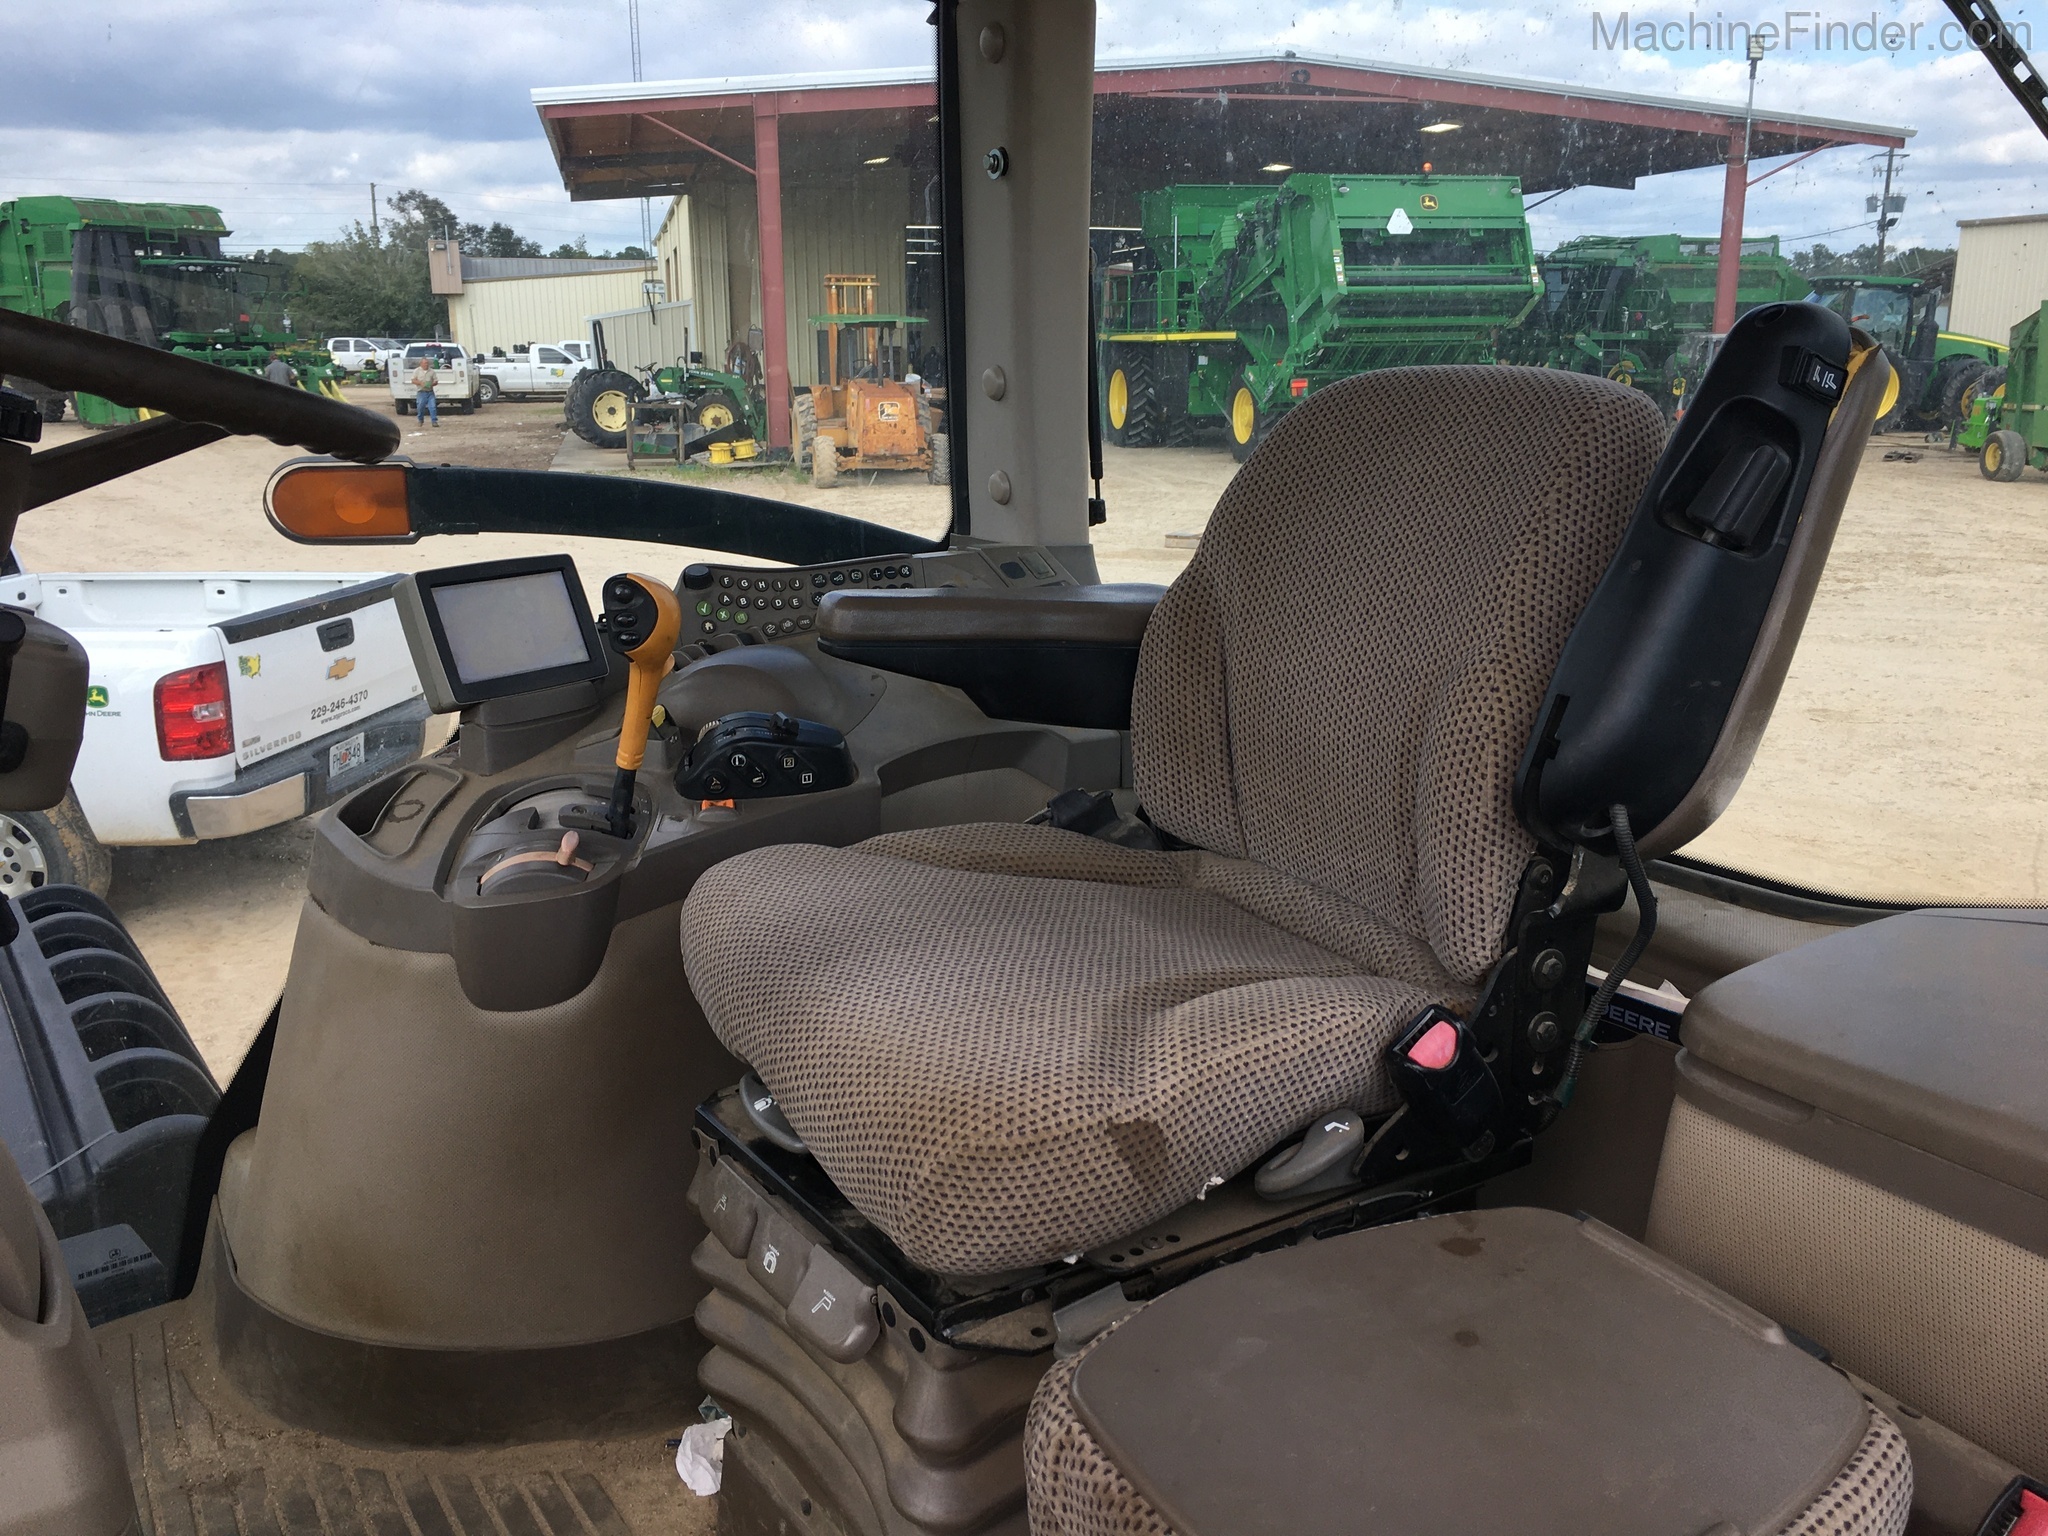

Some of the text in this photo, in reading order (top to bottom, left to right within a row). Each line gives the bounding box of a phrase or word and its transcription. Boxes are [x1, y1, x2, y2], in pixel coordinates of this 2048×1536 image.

[723, 577, 730, 585] F
[740, 597, 747, 605] B
[792, 598, 799, 606] E
[310, 689, 369, 721] 229-246-4370
[242, 731, 302, 761] SILVERADO
